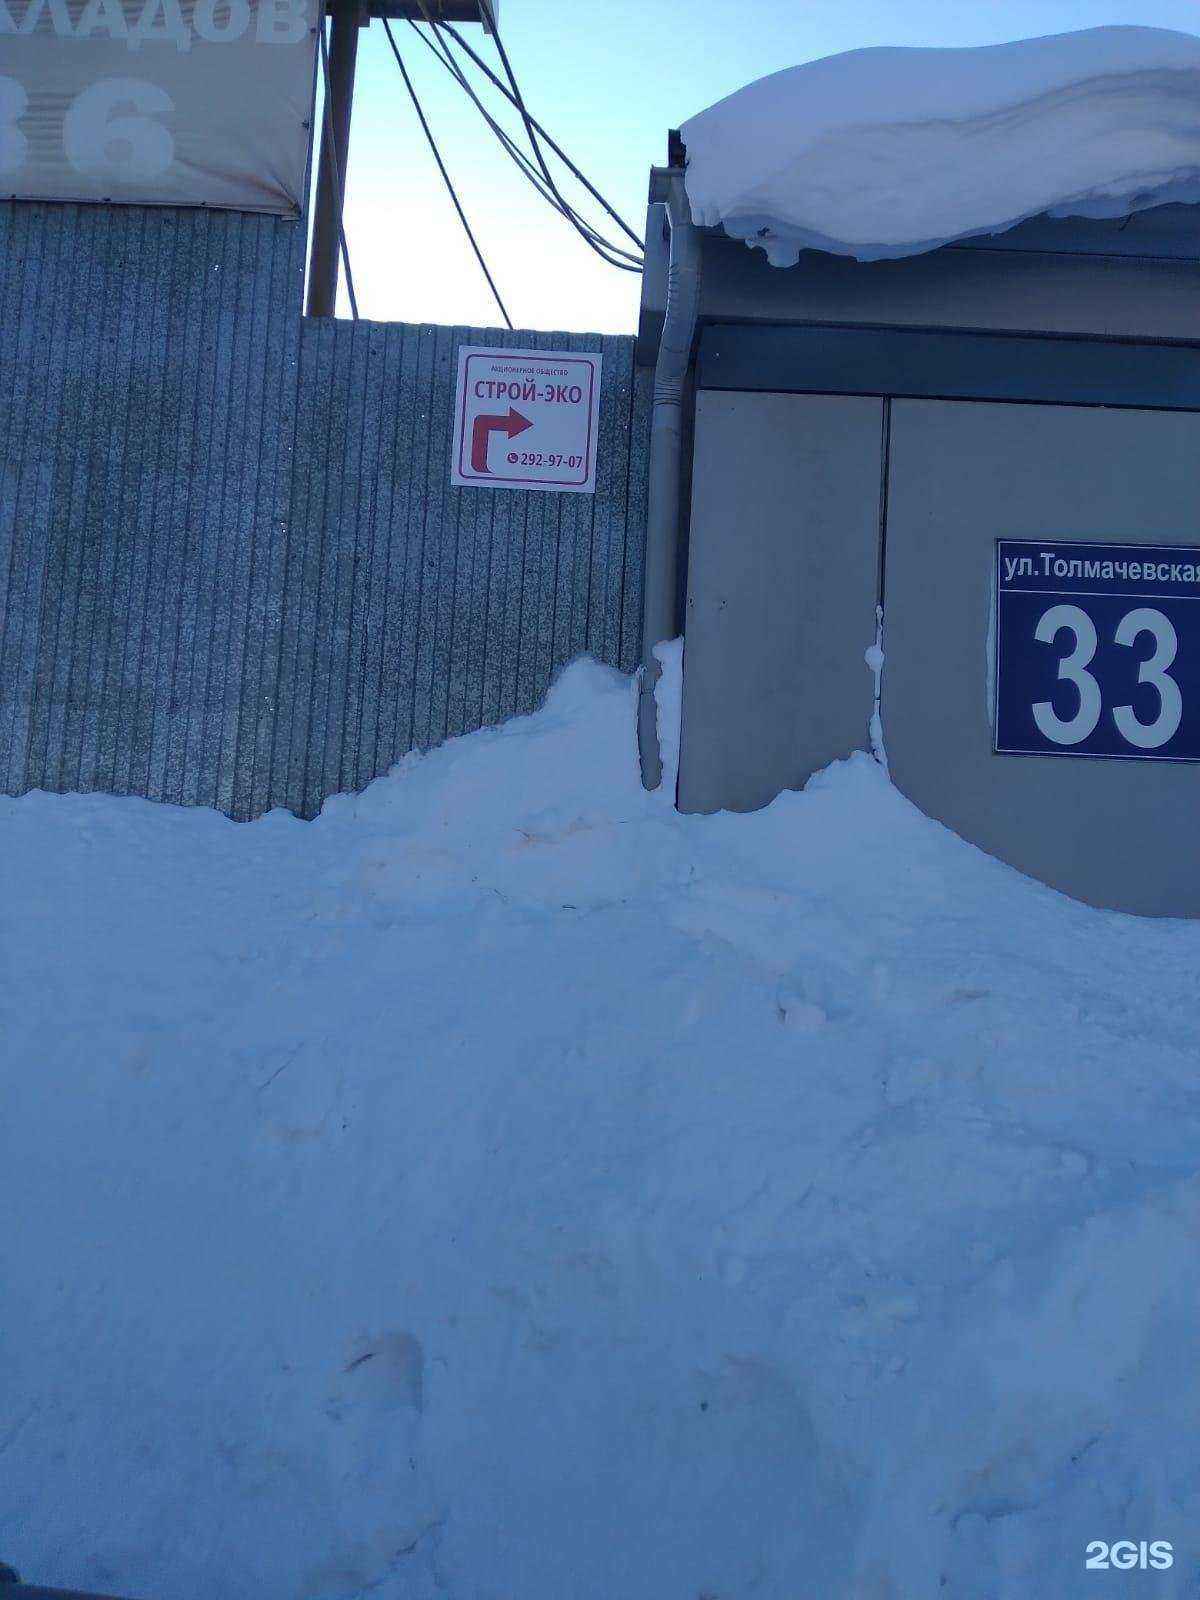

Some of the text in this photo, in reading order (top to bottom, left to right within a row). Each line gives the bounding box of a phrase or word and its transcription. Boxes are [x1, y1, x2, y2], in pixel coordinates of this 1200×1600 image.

[0, 0, 309, 54] ЛАДОВ
[490, 364, 569, 377] АКЦИОНЕРНОЕ ОБЩЕСТВО
[474, 377, 582, 404] СТРОЙ-ЭКО
[521, 452, 583, 469] 292-97-07
[1031, 604, 1183, 749] 33
